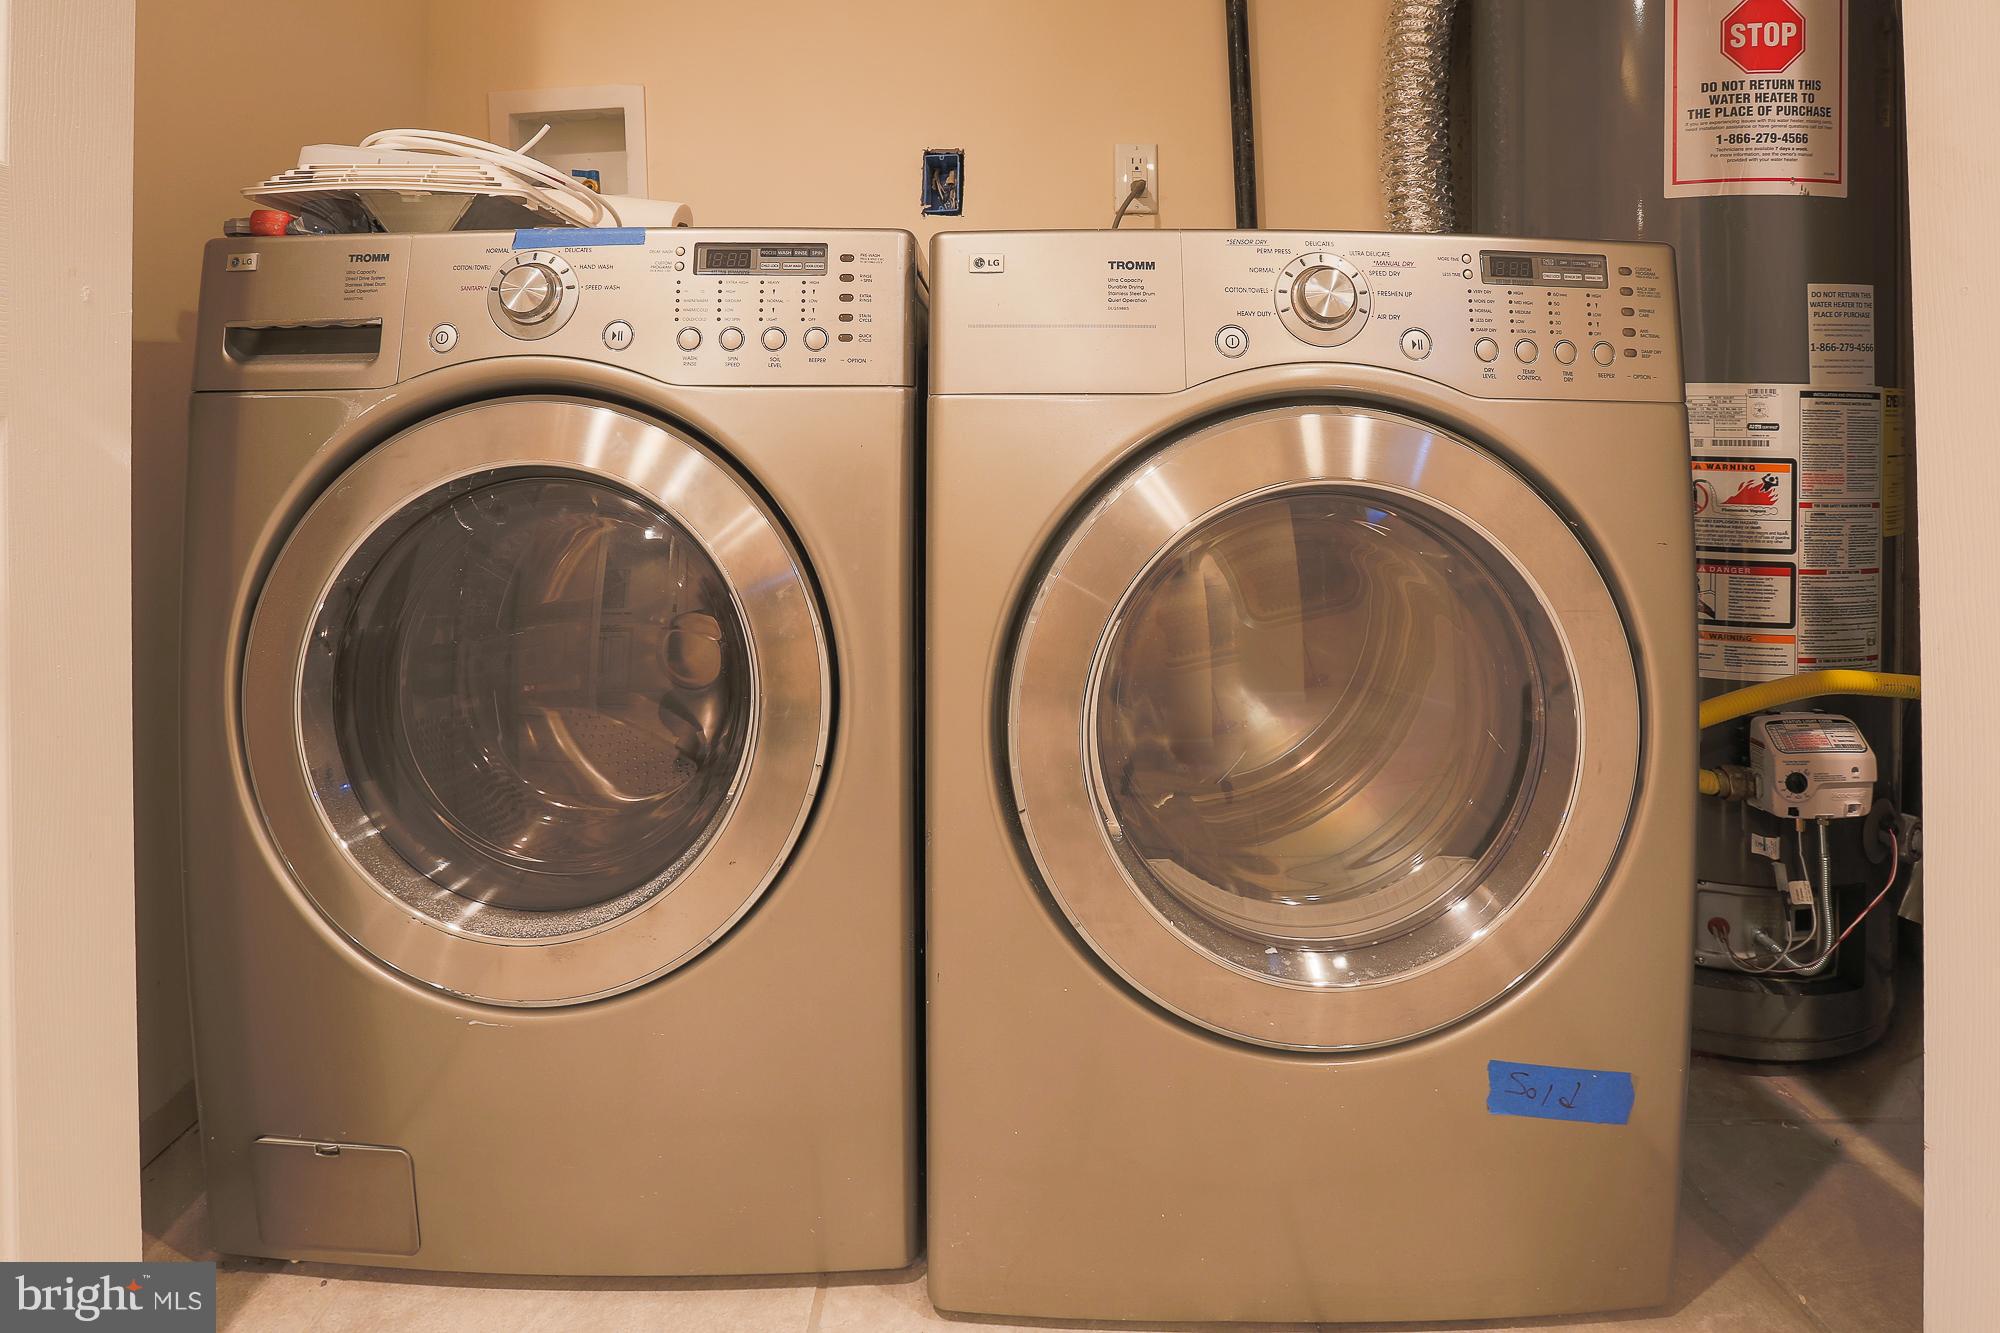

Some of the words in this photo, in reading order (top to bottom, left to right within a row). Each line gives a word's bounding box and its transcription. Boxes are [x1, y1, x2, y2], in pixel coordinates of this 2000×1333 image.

[1730, 22, 1797, 48] STOP
[1701, 82, 1717, 93] DO
[1722, 80, 1745, 91] NOT
[1750, 79, 1794, 90] RETURN
[1798, 80, 1821, 91] THIS
[1709, 93, 1750, 105] WATER
[1755, 93, 1798, 103] HEATER
[1801, 93, 1815, 103] TO
[1688, 109, 1711, 120] THE
[1715, 106, 1753, 118] PLACE
[1758, 106, 1772, 117] OF
[1776, 105, 1831, 118] PURCHASE
[1716, 133, 1808, 144] 1-866-279-4566
[241, 257, 253, 266] LG
[348, 253, 390, 262] TROMM
[988, 259, 1000, 267] LG
[1108, 261, 1156, 270] TROMM
[1810, 343, 1874, 352] 1-866-279-4566
[1706, 463, 1756, 471] WARNING
[1710, 566, 1751, 574] DANGER
[1709, 632, 1752, 642] WARNING
[1504, 1072, 1581, 1109] Sold
